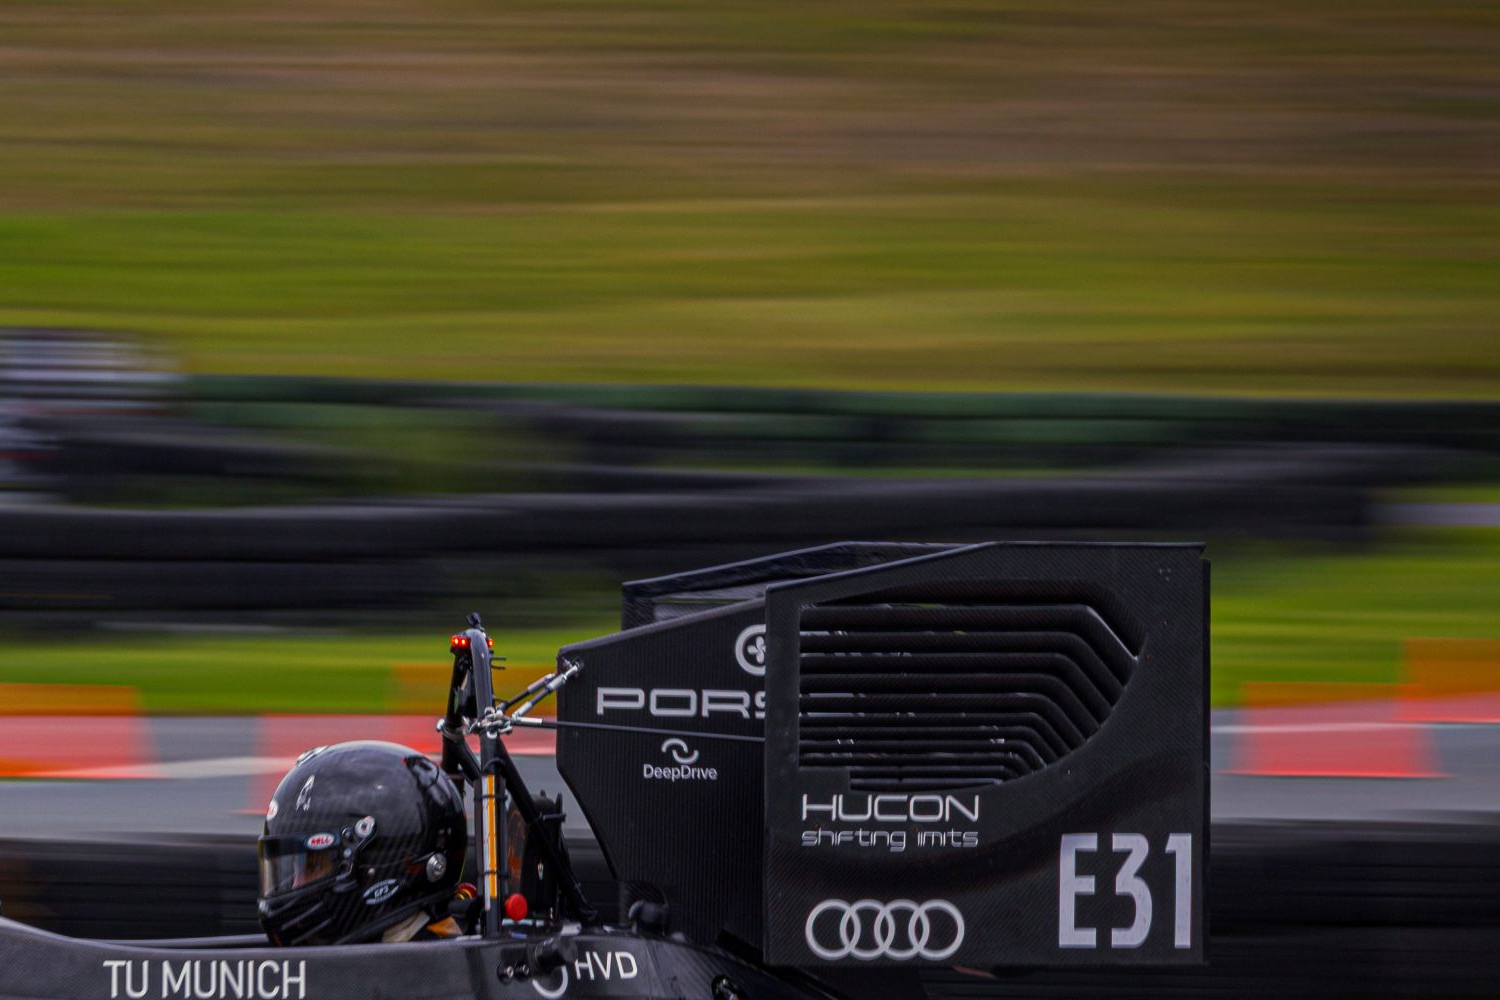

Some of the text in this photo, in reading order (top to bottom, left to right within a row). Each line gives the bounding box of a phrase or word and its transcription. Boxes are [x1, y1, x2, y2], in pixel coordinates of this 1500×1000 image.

[642, 763, 718, 783] DeepDrive
[802, 793, 980, 823] HUCON
[801, 828, 907, 852] shifting
[1058, 832, 1192, 949] E31
[102, 960, 307, 999] TU MUNICH
